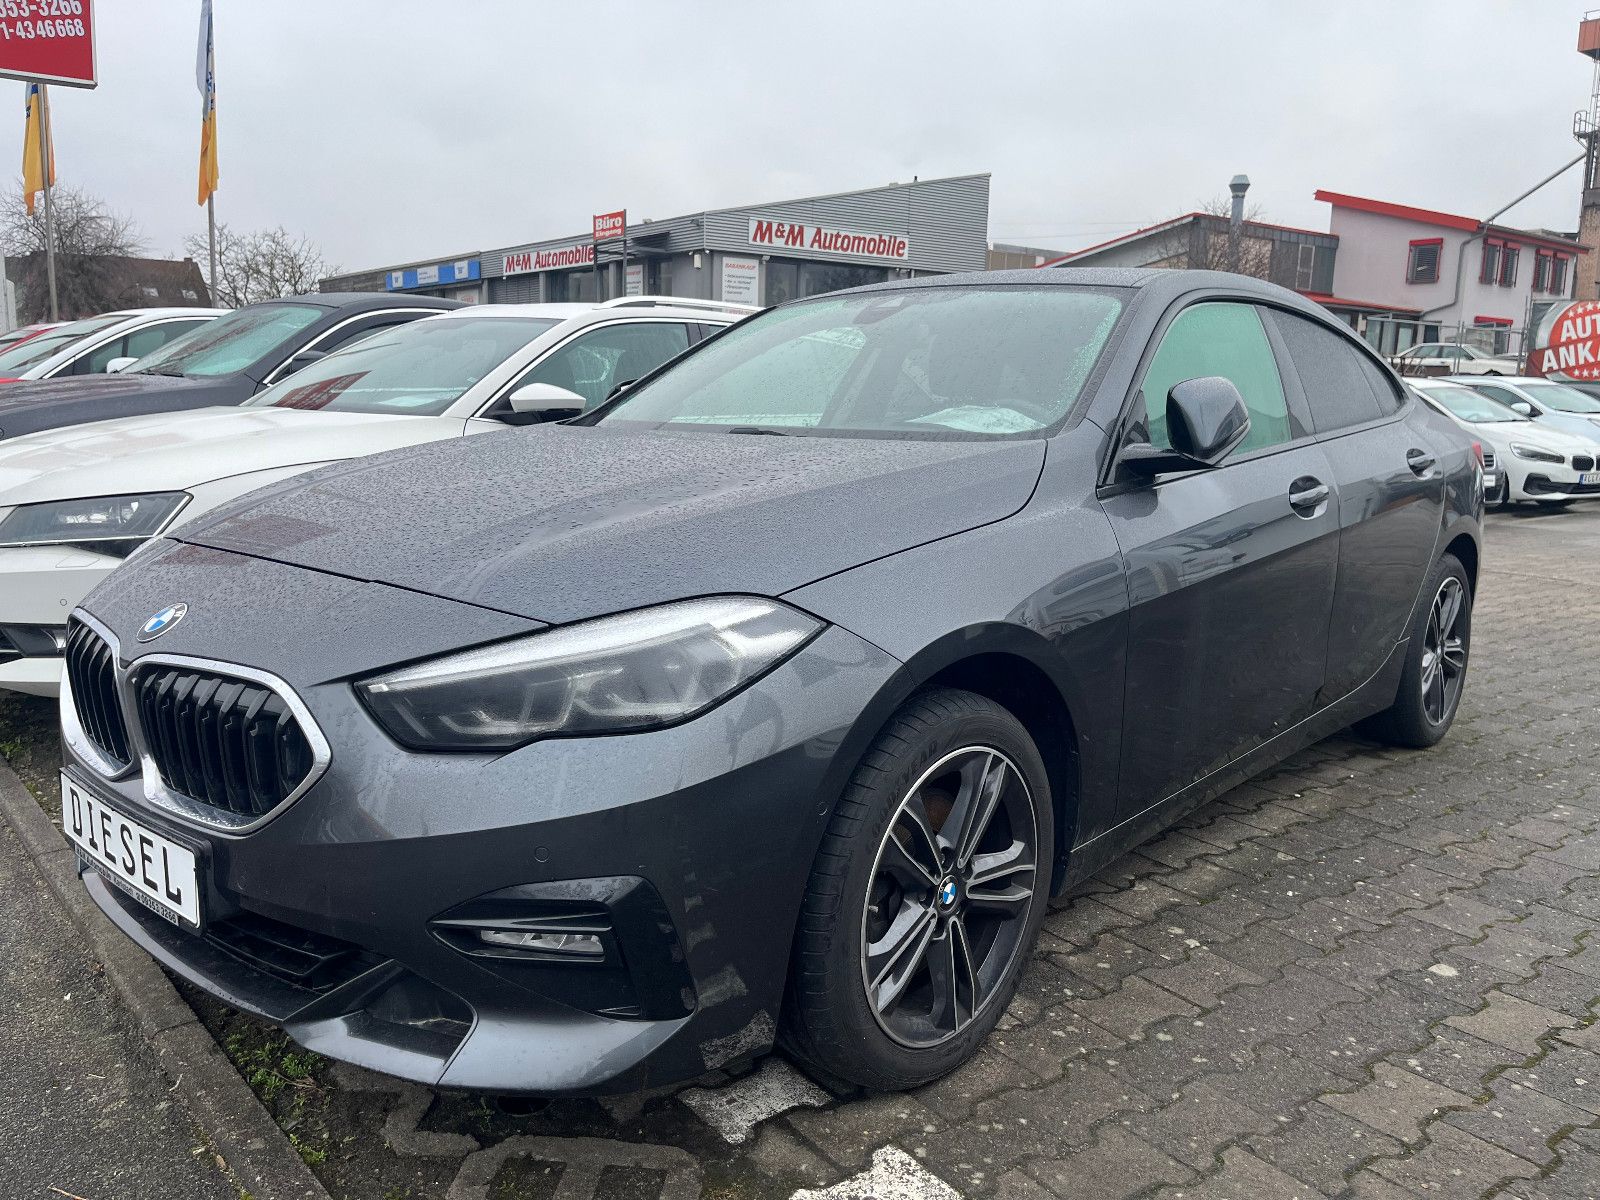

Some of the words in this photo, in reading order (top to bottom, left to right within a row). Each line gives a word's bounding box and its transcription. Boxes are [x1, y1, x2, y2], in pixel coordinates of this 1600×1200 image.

[596, 216, 622, 230] Büro
[752, 220, 805, 247] M&M
[810, 227, 906, 257] Automobile
[505, 254, 531, 273] M&M
[534, 245, 595, 269] Automobile
[1542, 340, 1600, 373] ANK
[69, 786, 182, 906] DIESEL
